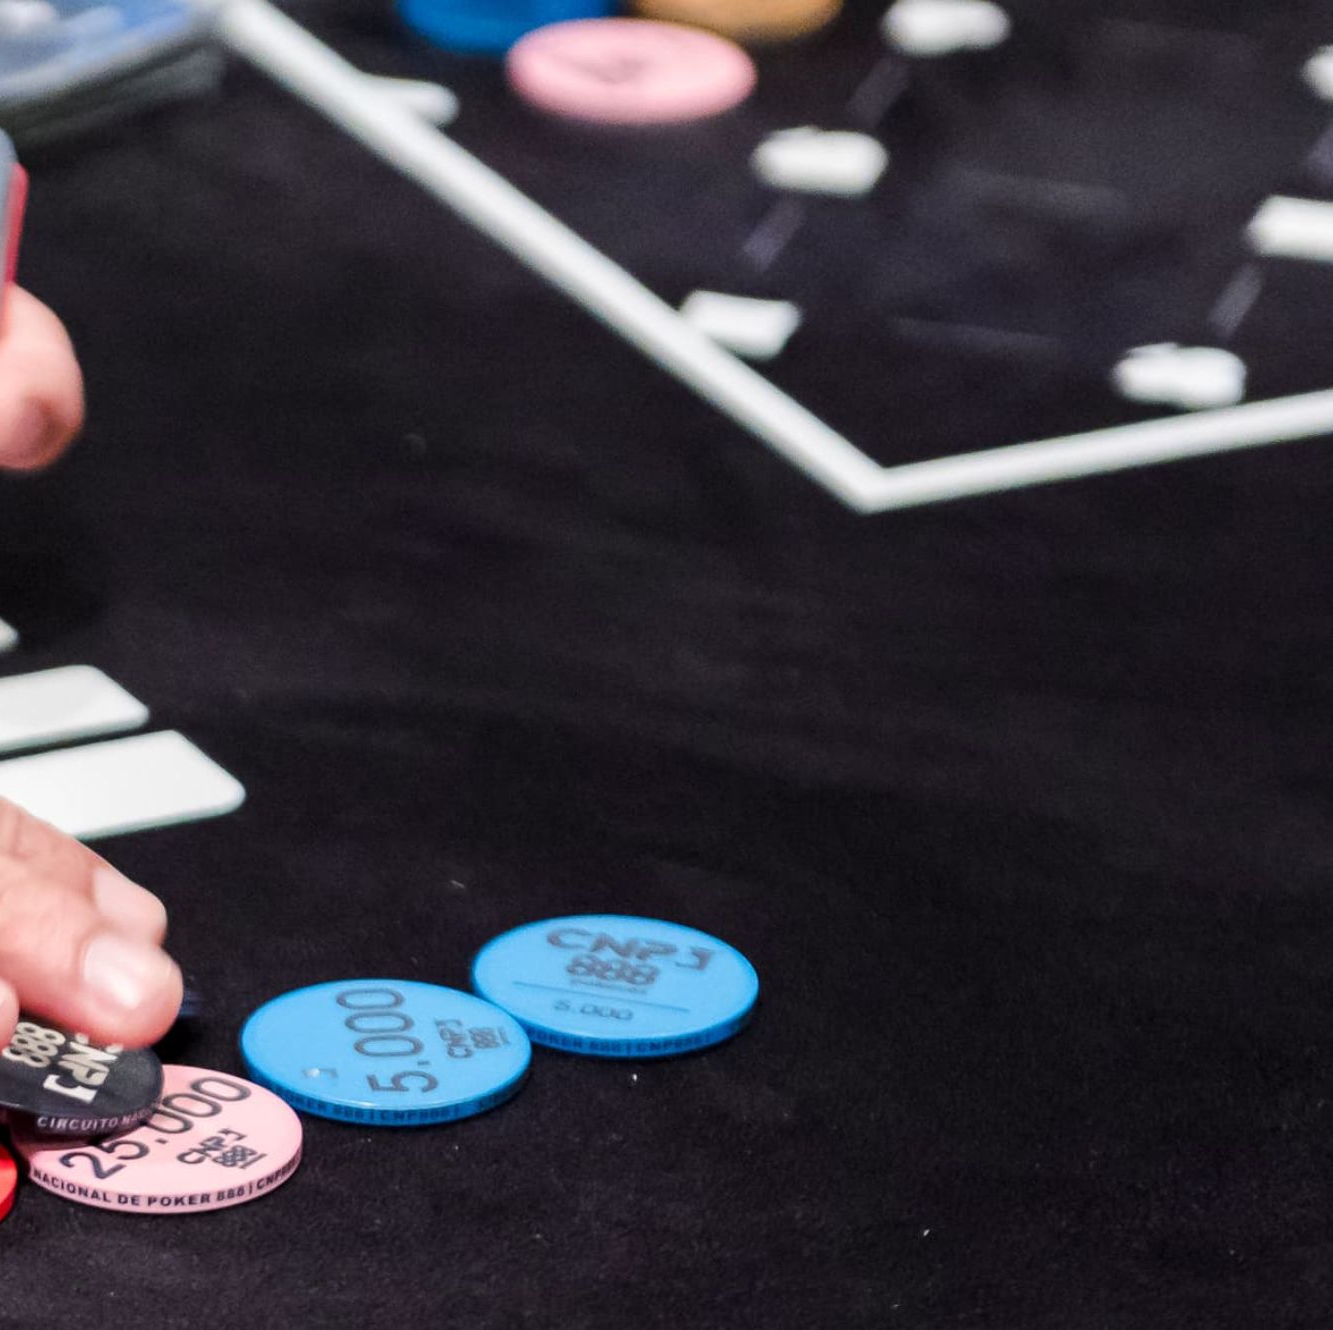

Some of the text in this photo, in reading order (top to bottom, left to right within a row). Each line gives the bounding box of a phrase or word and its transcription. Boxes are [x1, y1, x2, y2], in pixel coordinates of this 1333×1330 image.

[565, 953, 661, 986] 888
[553, 1000, 633, 1021] 5.000
[2, 1022, 65, 1068] 888
[336, 988, 439, 1093] 5.000
[36, 1114, 118, 1132] CIRCUITO
[59, 1076, 252, 1180] 25.000
[32, 1168, 110, 1203] NACIONAL
[117, 1194, 141, 1207] DE
[147, 1194, 210, 1208] POKER
